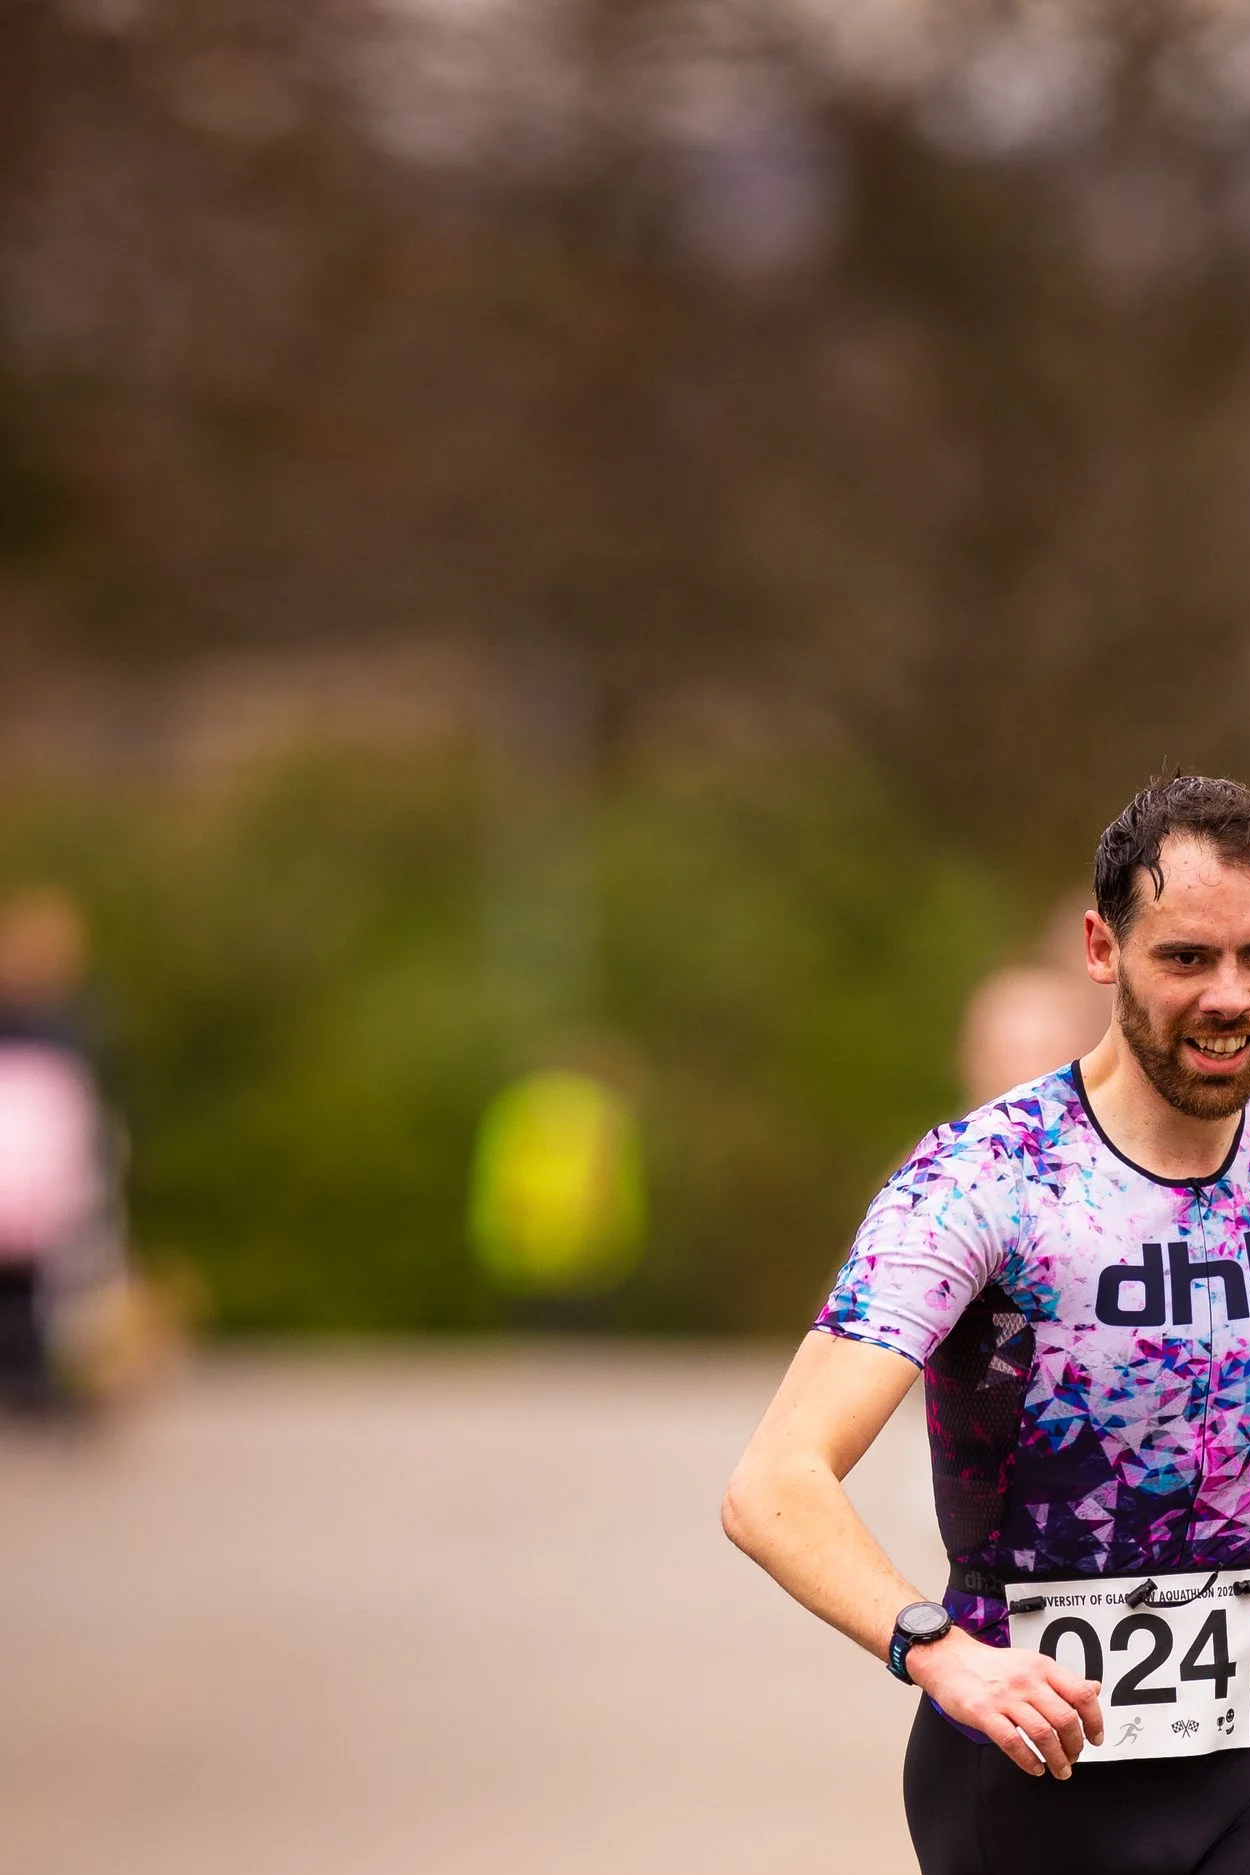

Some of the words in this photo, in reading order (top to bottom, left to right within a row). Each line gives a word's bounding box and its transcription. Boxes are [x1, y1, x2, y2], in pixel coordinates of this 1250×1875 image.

[1044, 1595, 1086, 1608] IVERSITY
[1090, 1595, 1102, 1605] OF
[1159, 1587, 1214, 1602] AQUATHLON
[1217, 1585, 1234, 1597] 202
[1039, 1609, 1236, 1707] 024
